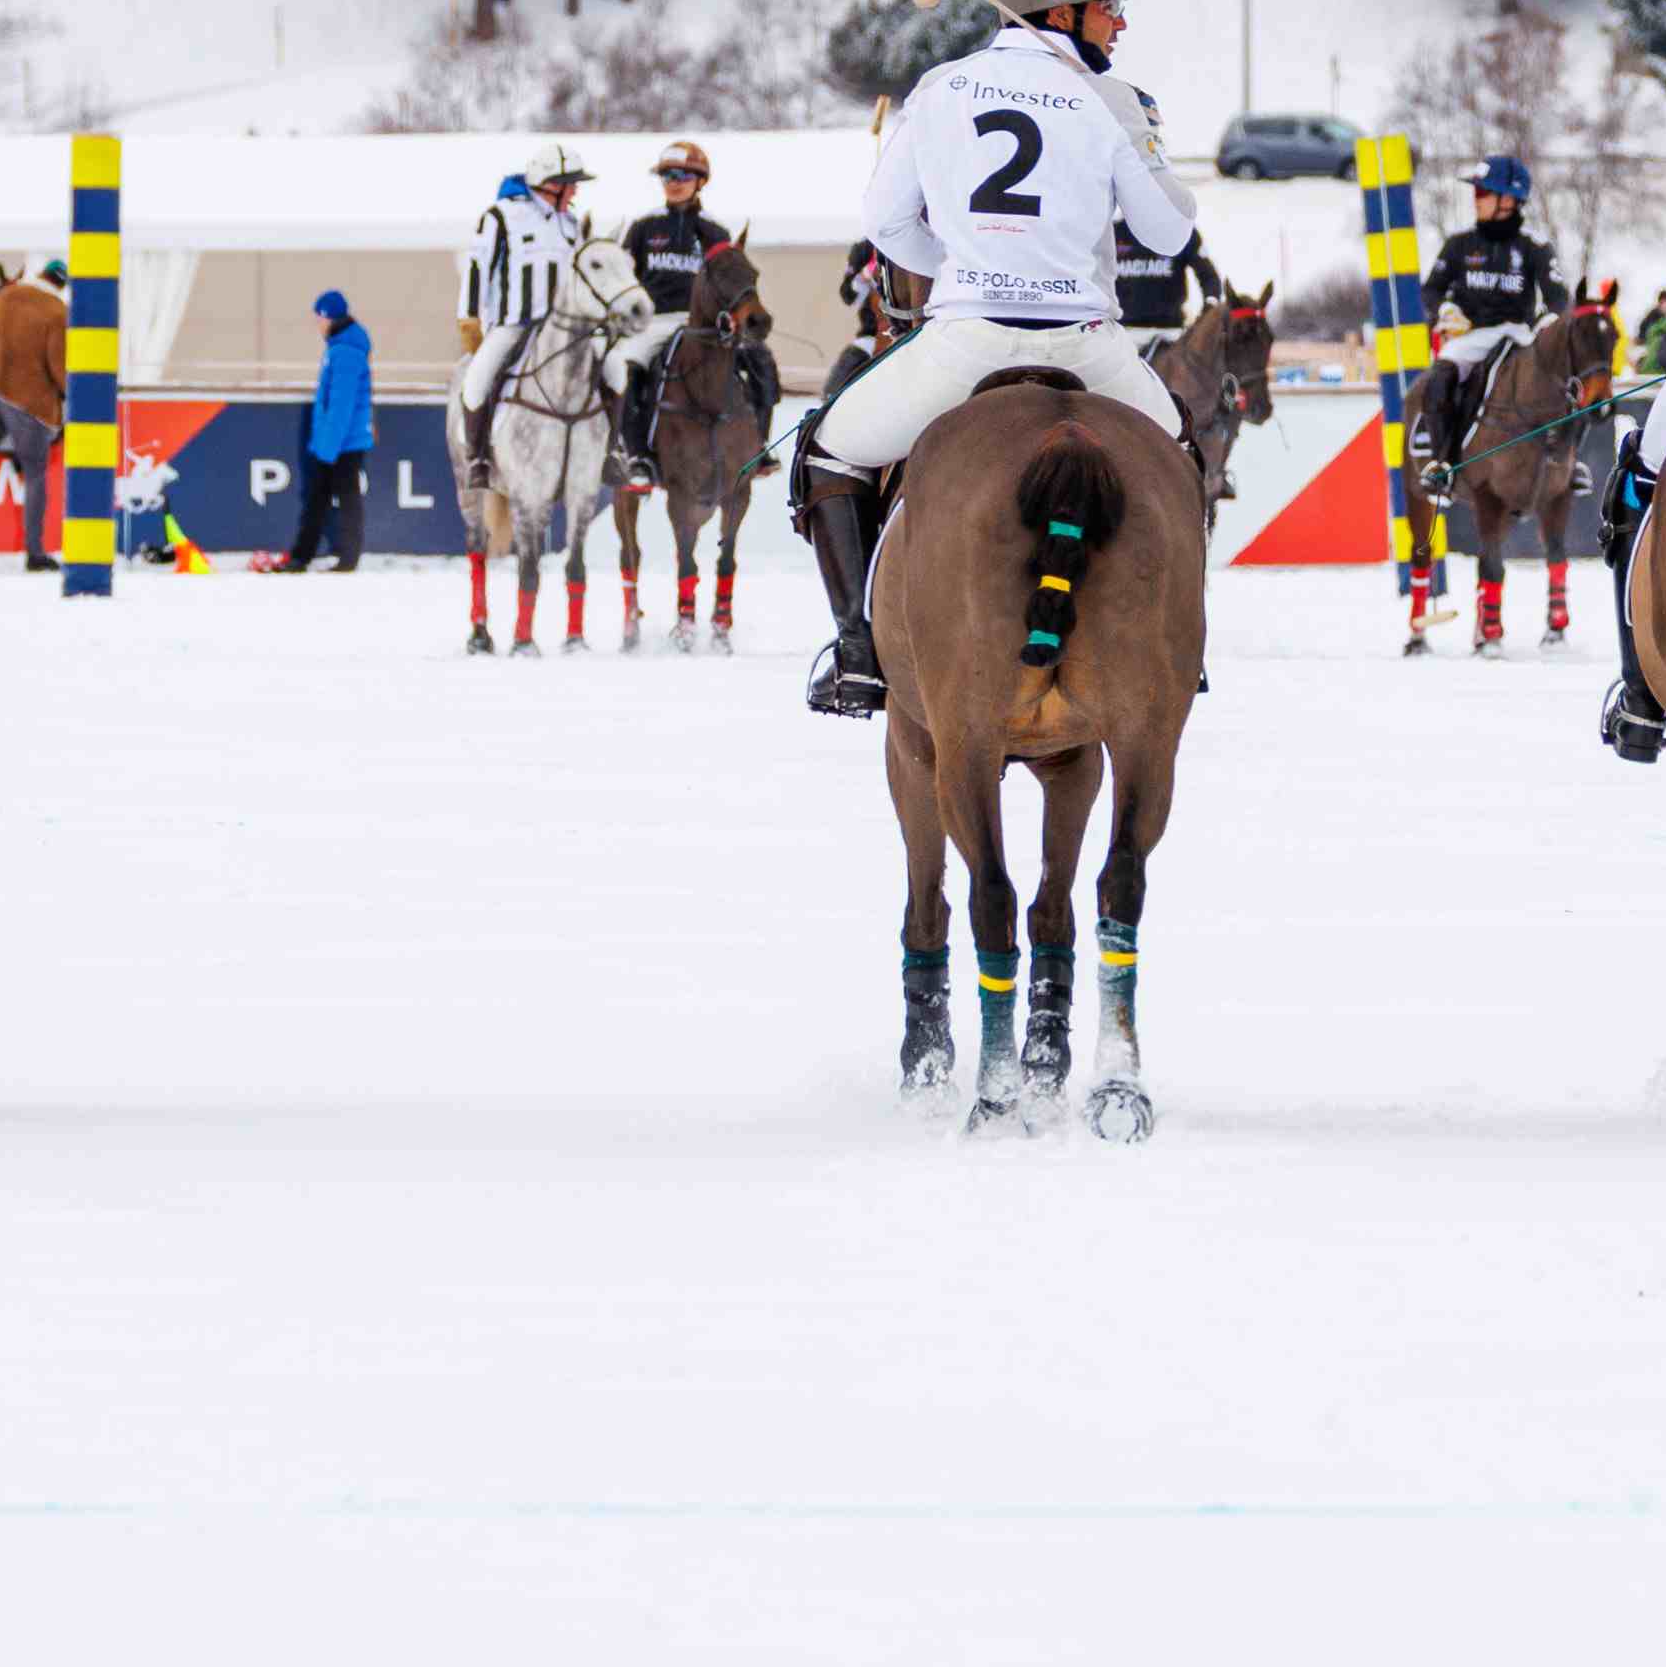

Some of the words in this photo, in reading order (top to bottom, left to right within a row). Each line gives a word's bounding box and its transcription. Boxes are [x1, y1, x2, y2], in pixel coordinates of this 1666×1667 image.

[972, 81, 1085, 111] Investec
[968, 108, 1044, 217] 2
[982, 272, 1026, 289] POLO
